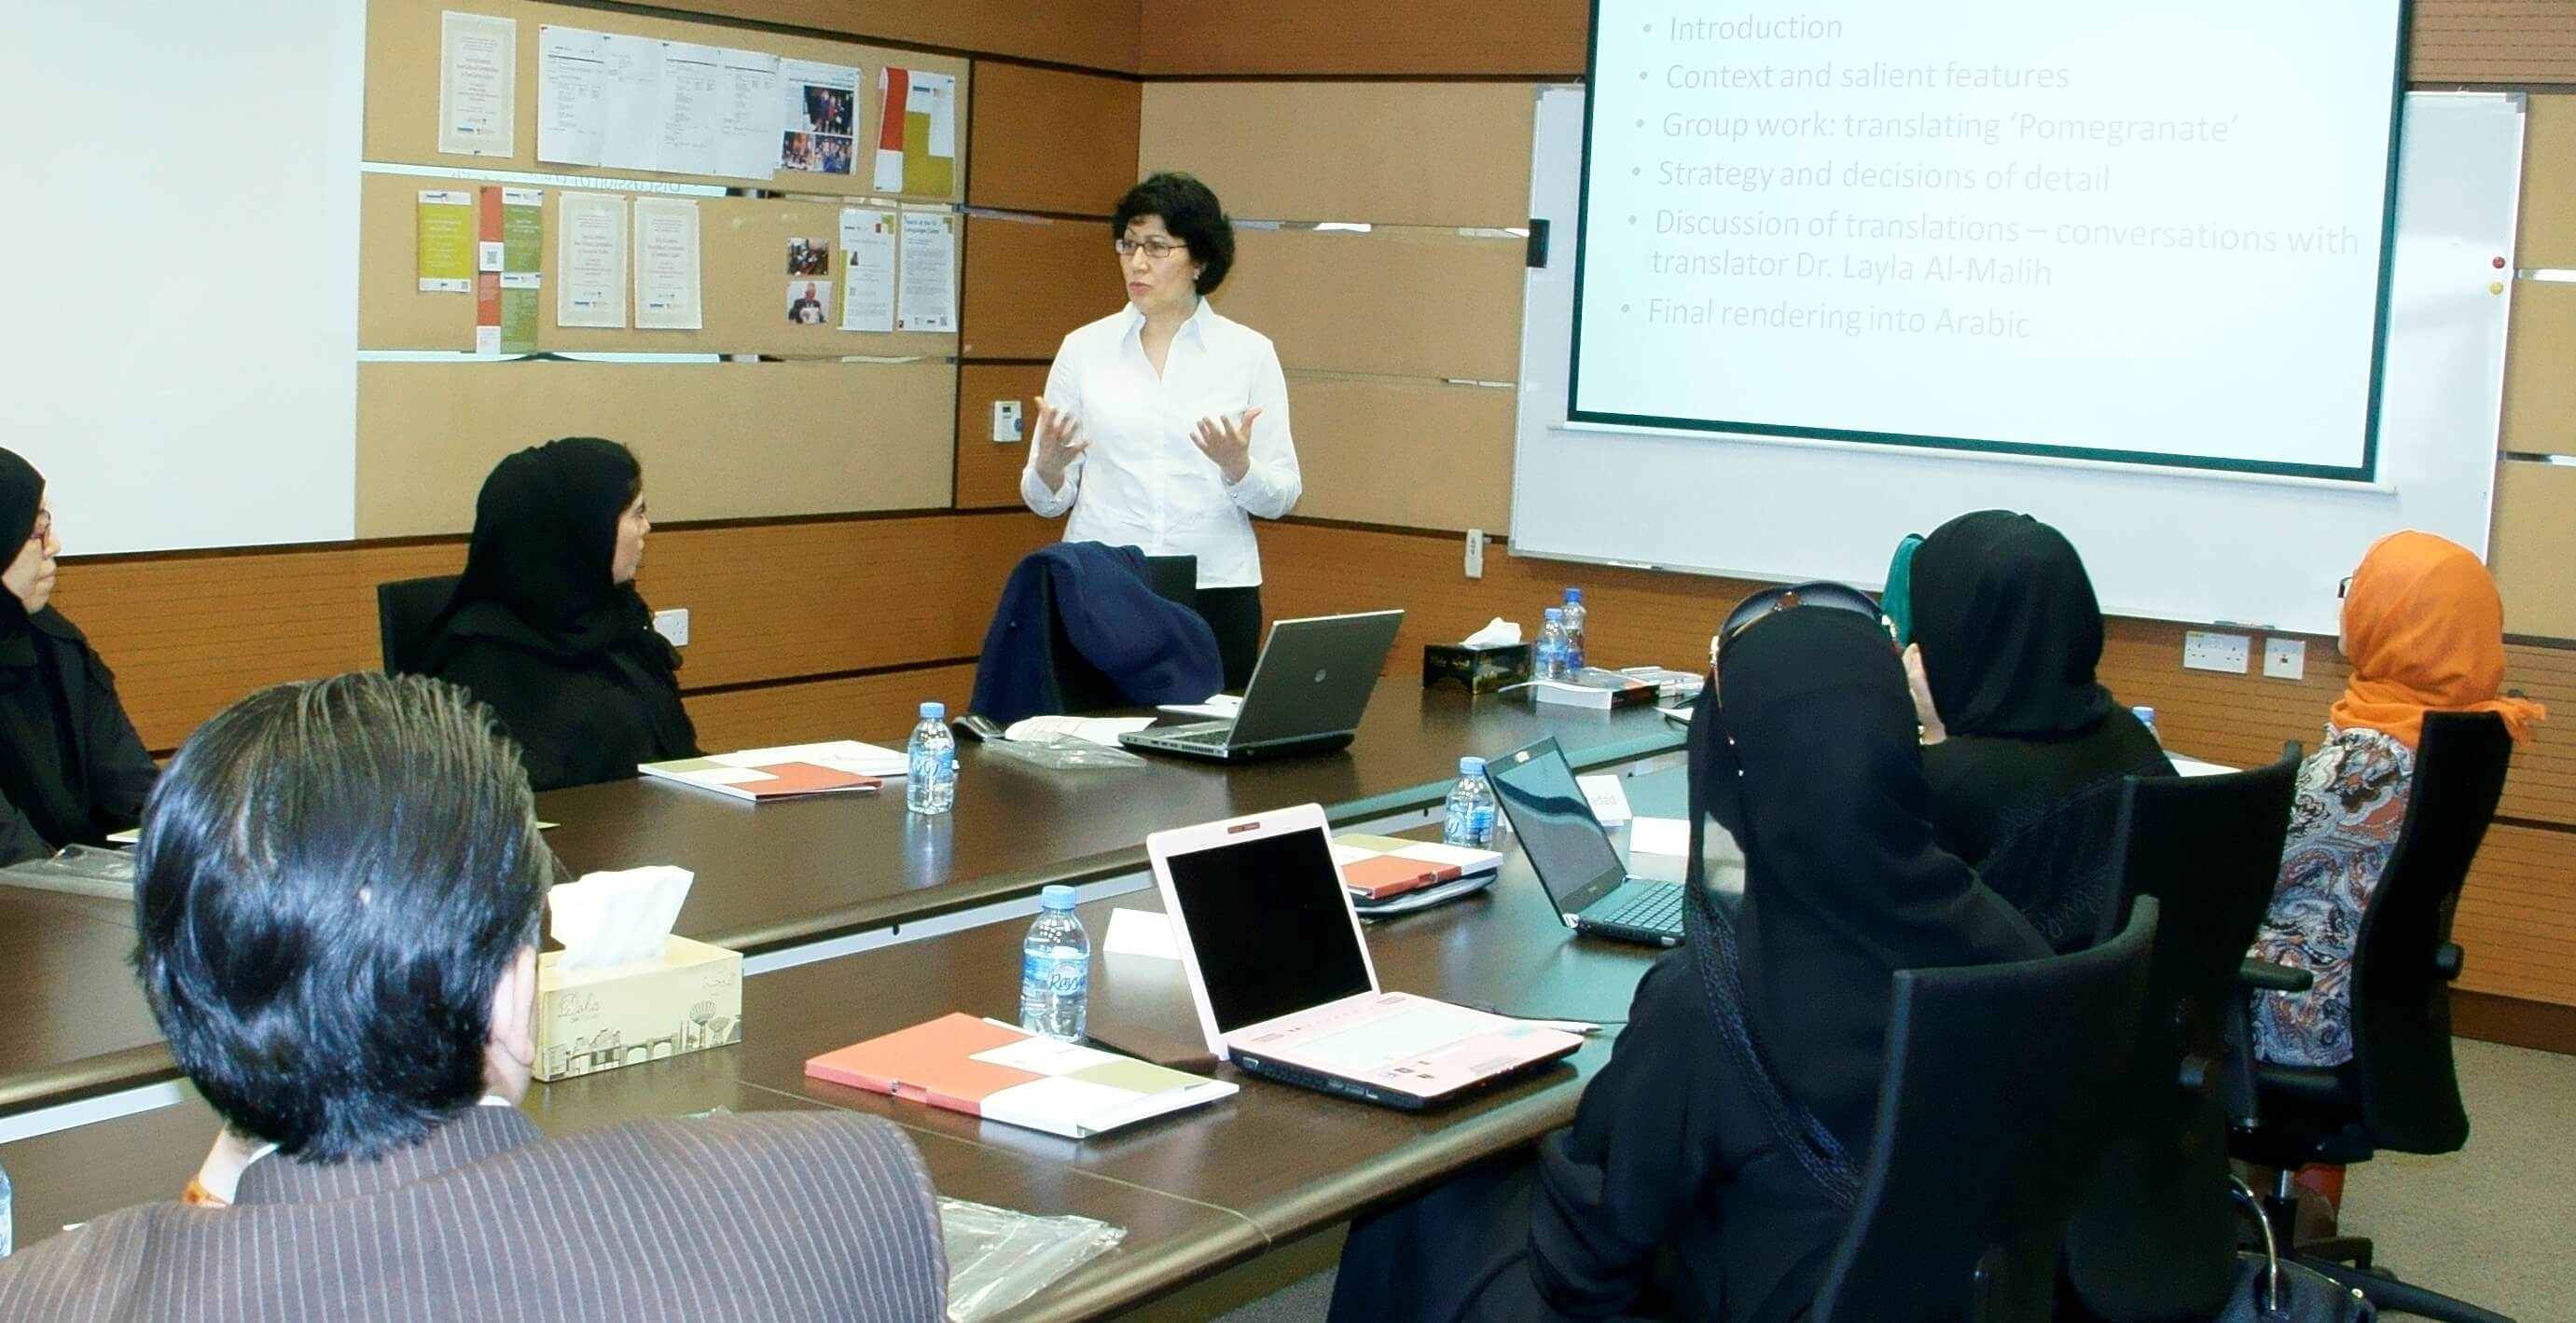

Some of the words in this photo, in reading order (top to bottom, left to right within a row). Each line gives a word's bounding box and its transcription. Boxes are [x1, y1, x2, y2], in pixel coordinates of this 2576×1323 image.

[1669, 13, 1843, 42] Introduction
[1666, 62, 1776, 89] Context
[1779, 62, 1833, 89] and
[1840, 61, 1937, 89] salient
[1944, 60, 2069, 89] features
[1662, 112, 1749, 144] Group
[1755, 110, 1836, 137] work:
[1844, 111, 2001, 146] translating
[1657, 159, 1775, 193] Strategy
[1780, 159, 1833, 187] and
[1842, 159, 1976, 190] decisions
[1986, 161, 2017, 191] of
[2024, 163, 2110, 193] detail
[1655, 208, 1799, 237] Discussion
[1807, 209, 1839, 238] of
[1845, 212, 2019, 243] translations
[2056, 222, 2277, 253] conversations
[2287, 225, 2359, 255] with
[1650, 248, 1790, 277] translator
[1796, 251, 1832, 278] Dr.
[1843, 253, 1914, 286] Layla
[1924, 255, 2052, 285] Al-Malih
[1648, 297, 1713, 325] Final
[1721, 299, 1863, 337] rendering
[1869, 304, 1926, 334] into
[1933, 307, 2030, 338] Arabic
